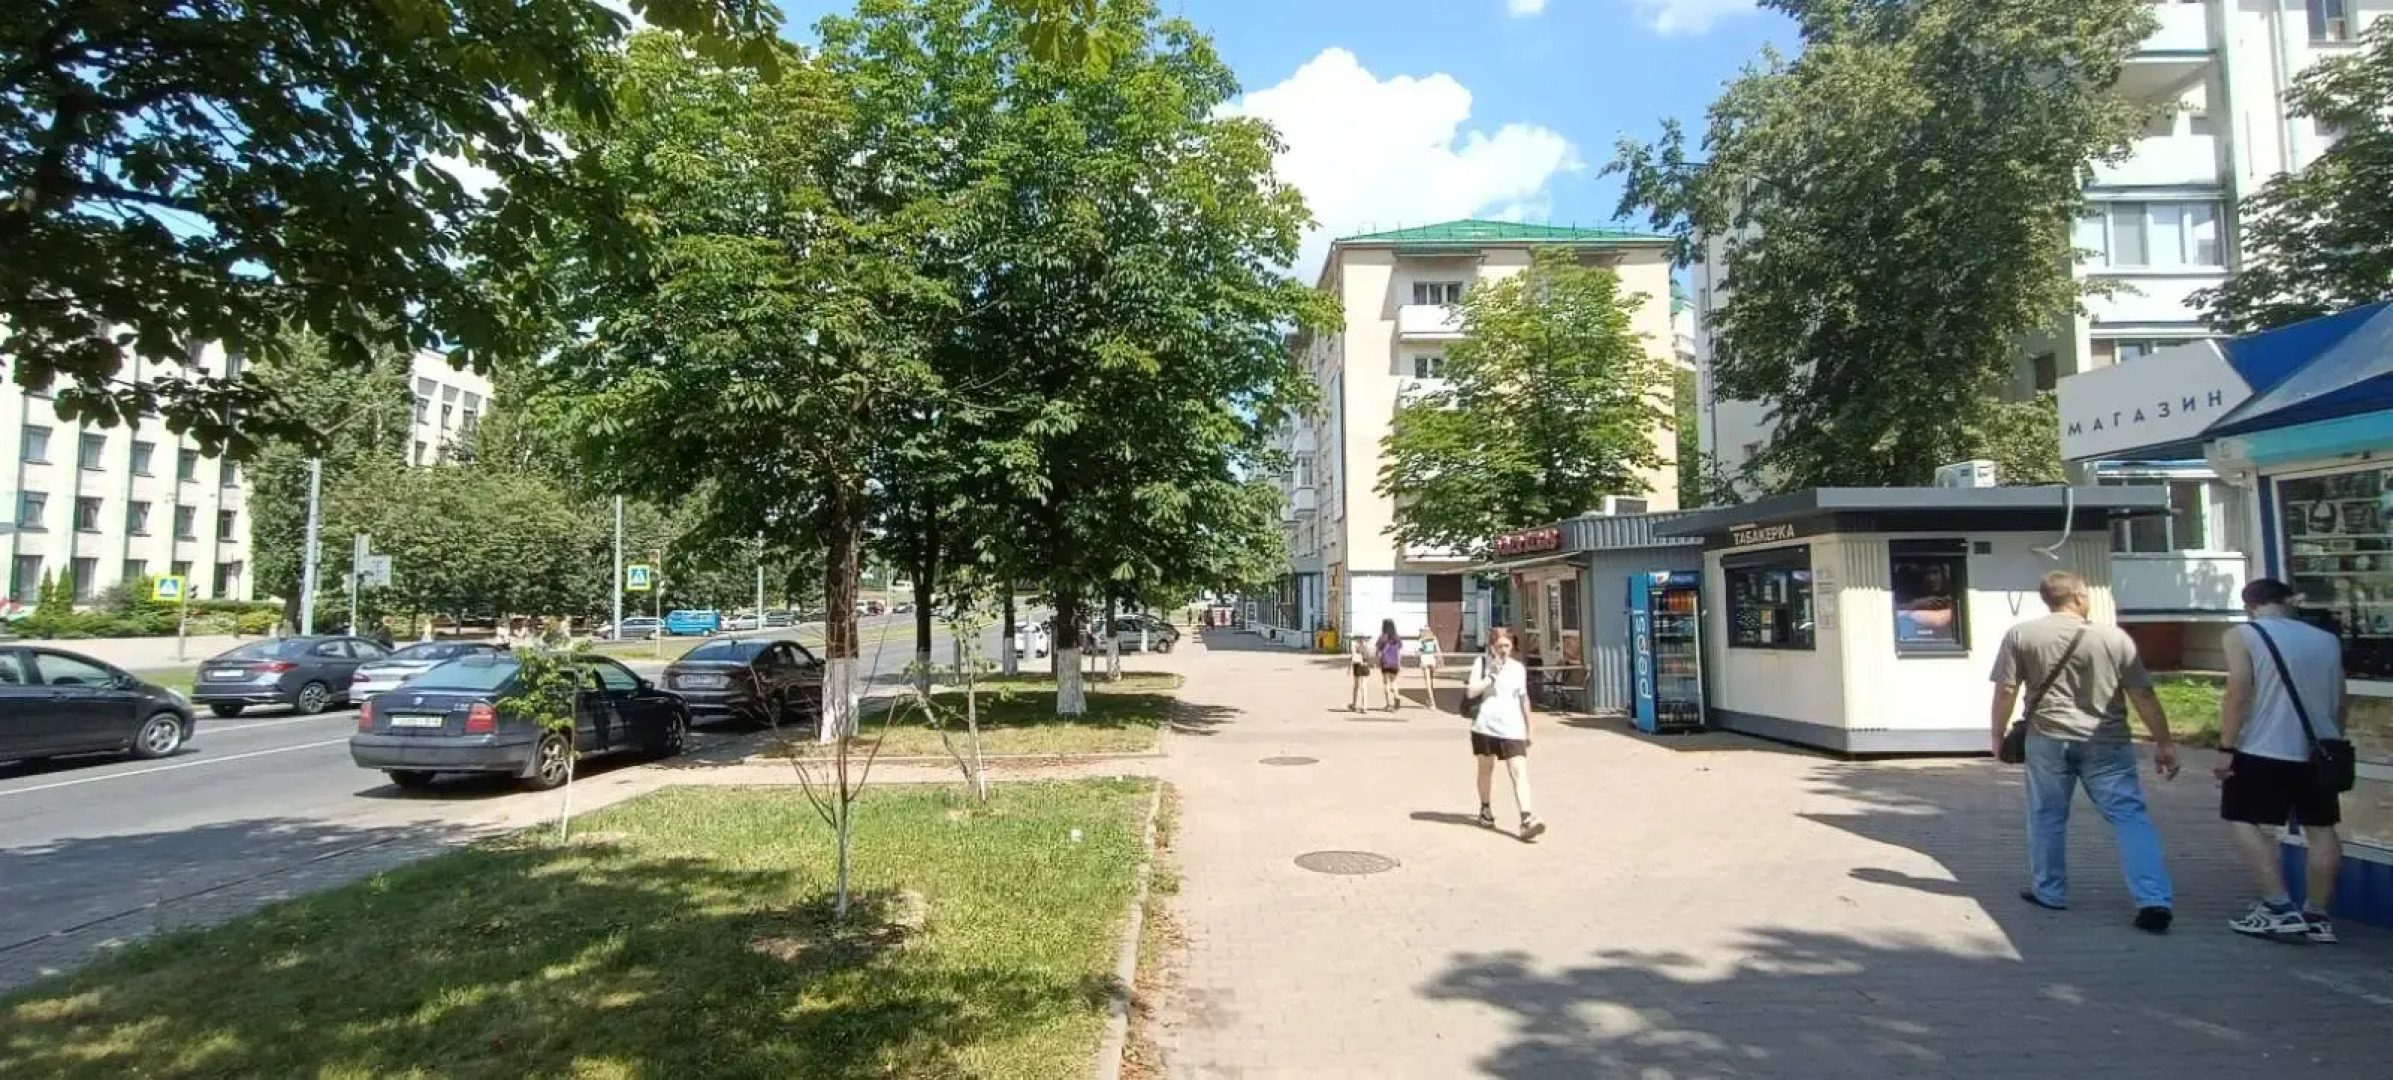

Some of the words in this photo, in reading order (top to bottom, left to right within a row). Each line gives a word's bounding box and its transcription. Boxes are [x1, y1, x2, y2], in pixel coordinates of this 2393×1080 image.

[2067, 389, 2224, 436] МАГАЗИН
[1733, 523, 1796, 545] ТАБАКЕРКА
[1632, 609, 1652, 699] pepsi
